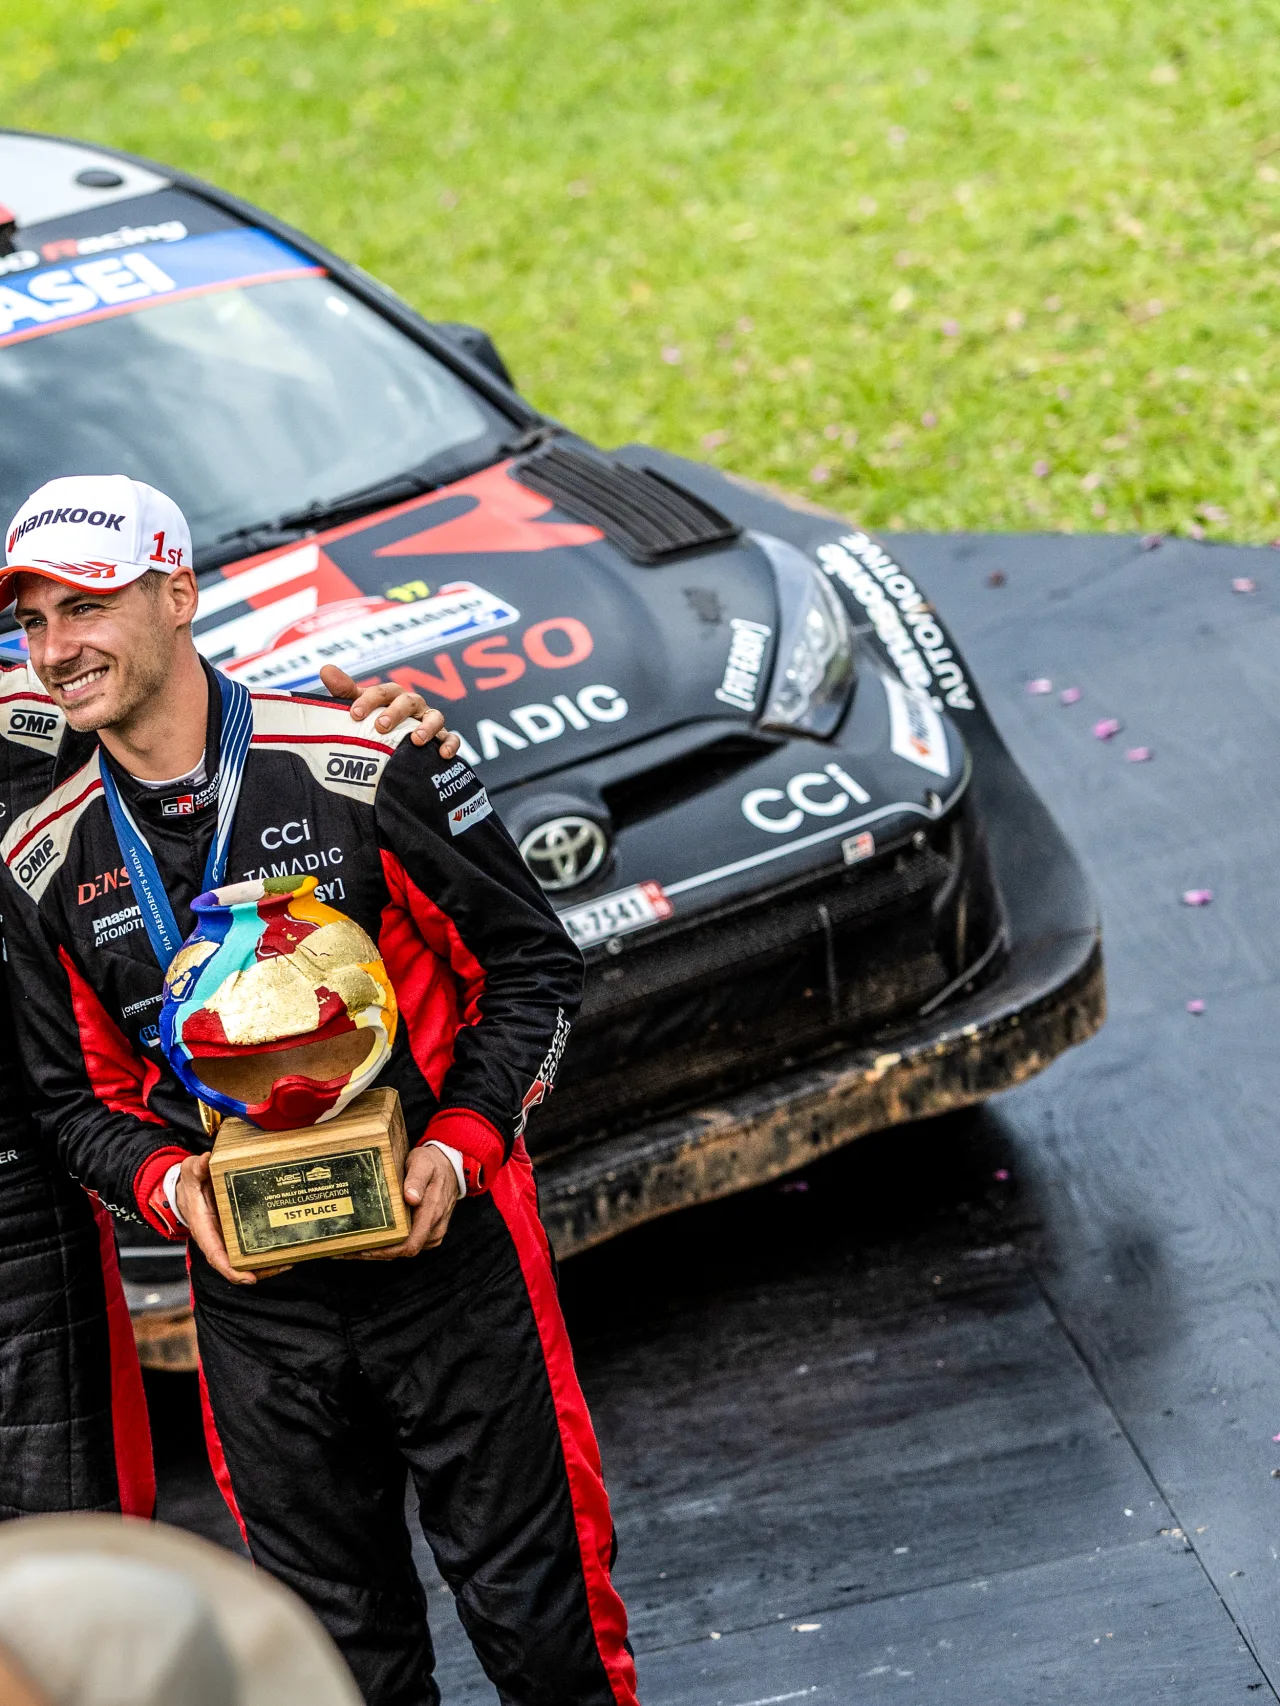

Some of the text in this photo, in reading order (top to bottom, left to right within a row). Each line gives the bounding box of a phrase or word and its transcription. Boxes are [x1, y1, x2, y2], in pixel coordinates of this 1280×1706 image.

[41, 220, 188, 262] Racing
[148, 530, 184, 567] 1st
[356, 617, 594, 702] NSO
[9, 713, 58, 735] OMP
[326, 757, 378, 782] OMP
[163, 801, 193, 814] GR
[18, 838, 55, 884] OMP
[76, 865, 132, 906] DENS
[266, 1188, 350, 1209] OVERALL CLASSIFICATION
[283, 1203, 338, 1221] 1ST PLACE
